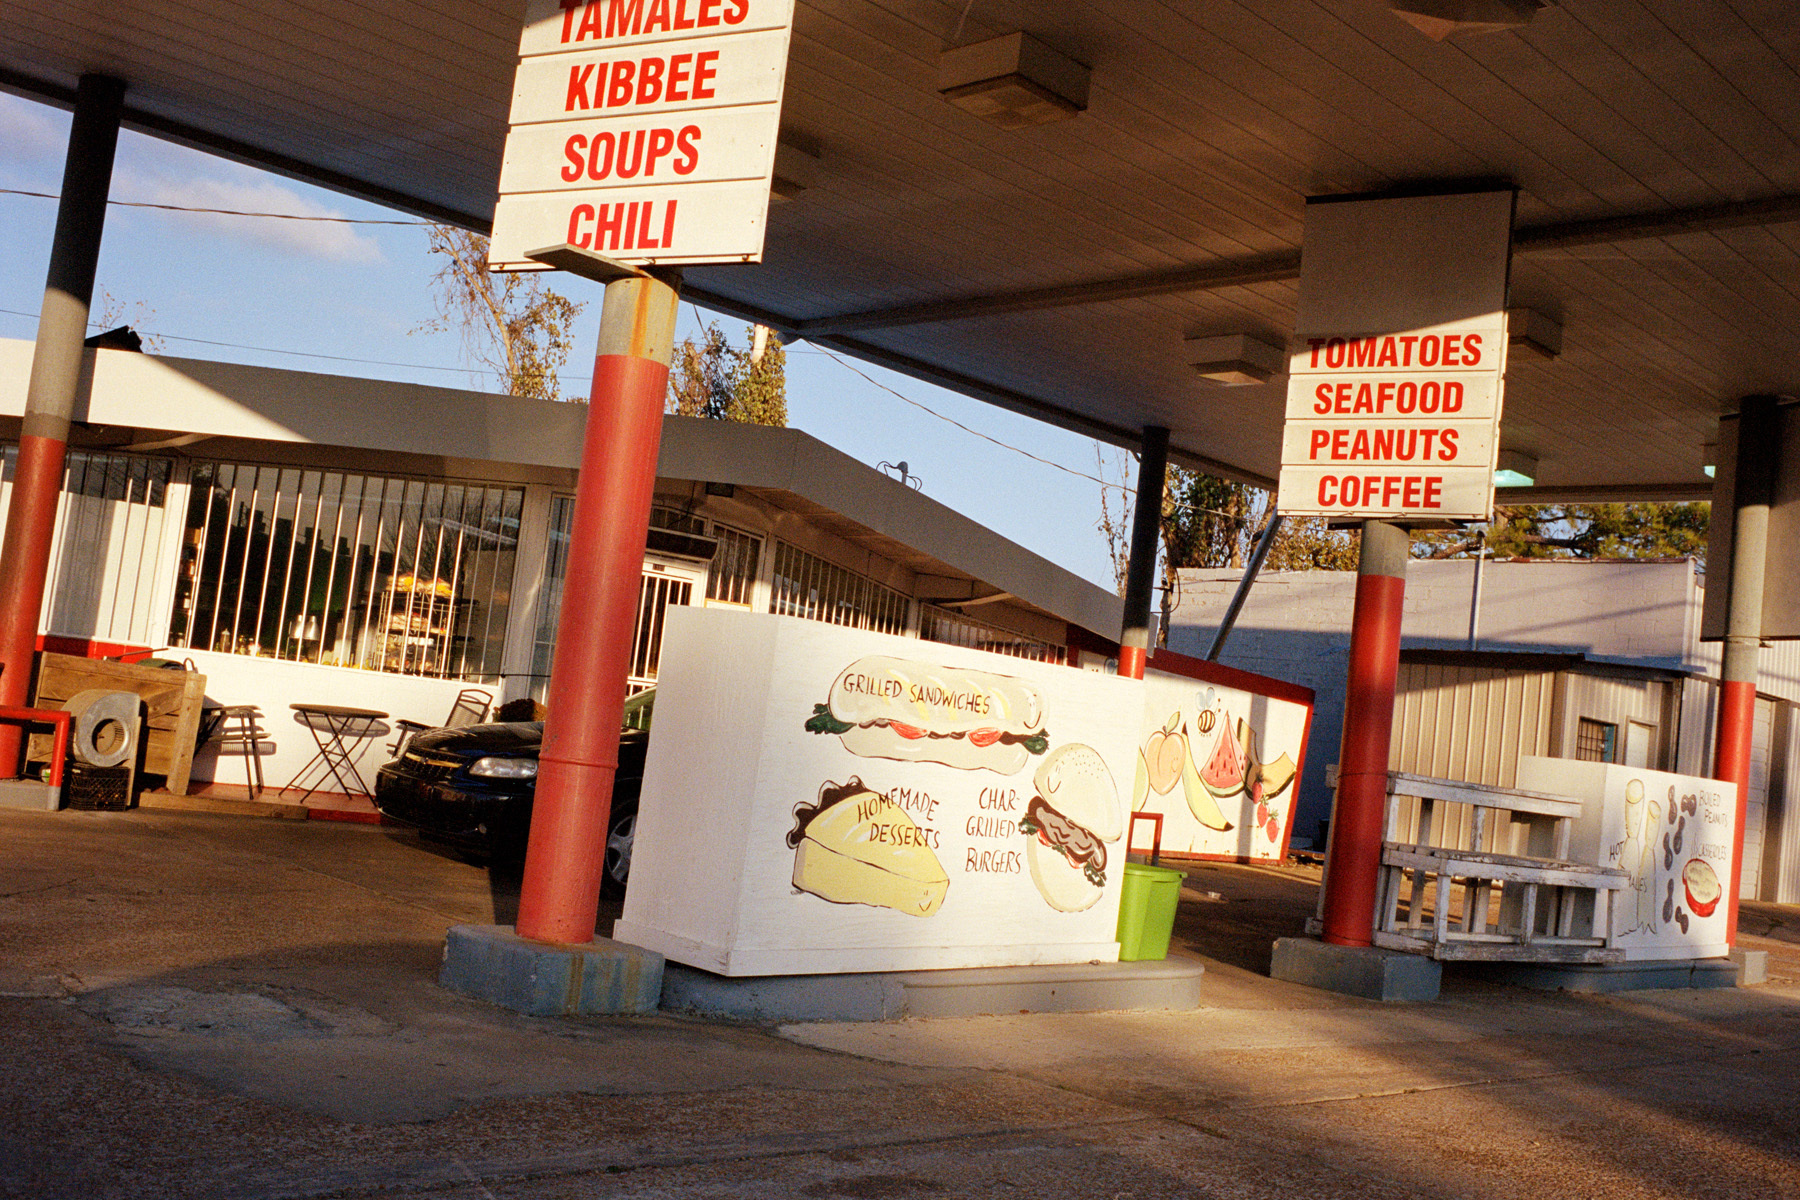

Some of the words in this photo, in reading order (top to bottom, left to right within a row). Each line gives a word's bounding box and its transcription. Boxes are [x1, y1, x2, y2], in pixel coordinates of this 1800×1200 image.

[559, 0, 750, 44] TAMALES
[564, 50, 720, 112] KIBBEE
[560, 124, 702, 182] SOUPS
[566, 200, 678, 251] CHILI
[1307, 333, 1483, 369] TOMATOES
[1313, 381, 1464, 415] SEAFOOD
[1309, 428, 1459, 461] PEANUTS
[1317, 475, 1443, 509] COFFEE
[843, 673, 903, 698] GRILLED
[909, 684, 991, 715] SANDWICHES
[857, 787, 940, 824] HOMEMADE
[869, 823, 940, 849] DESSERTS
[966, 815, 1016, 839] GRILLED
[965, 847, 1022, 874] BURGERS
[1608, 840, 1625, 862] HOT
